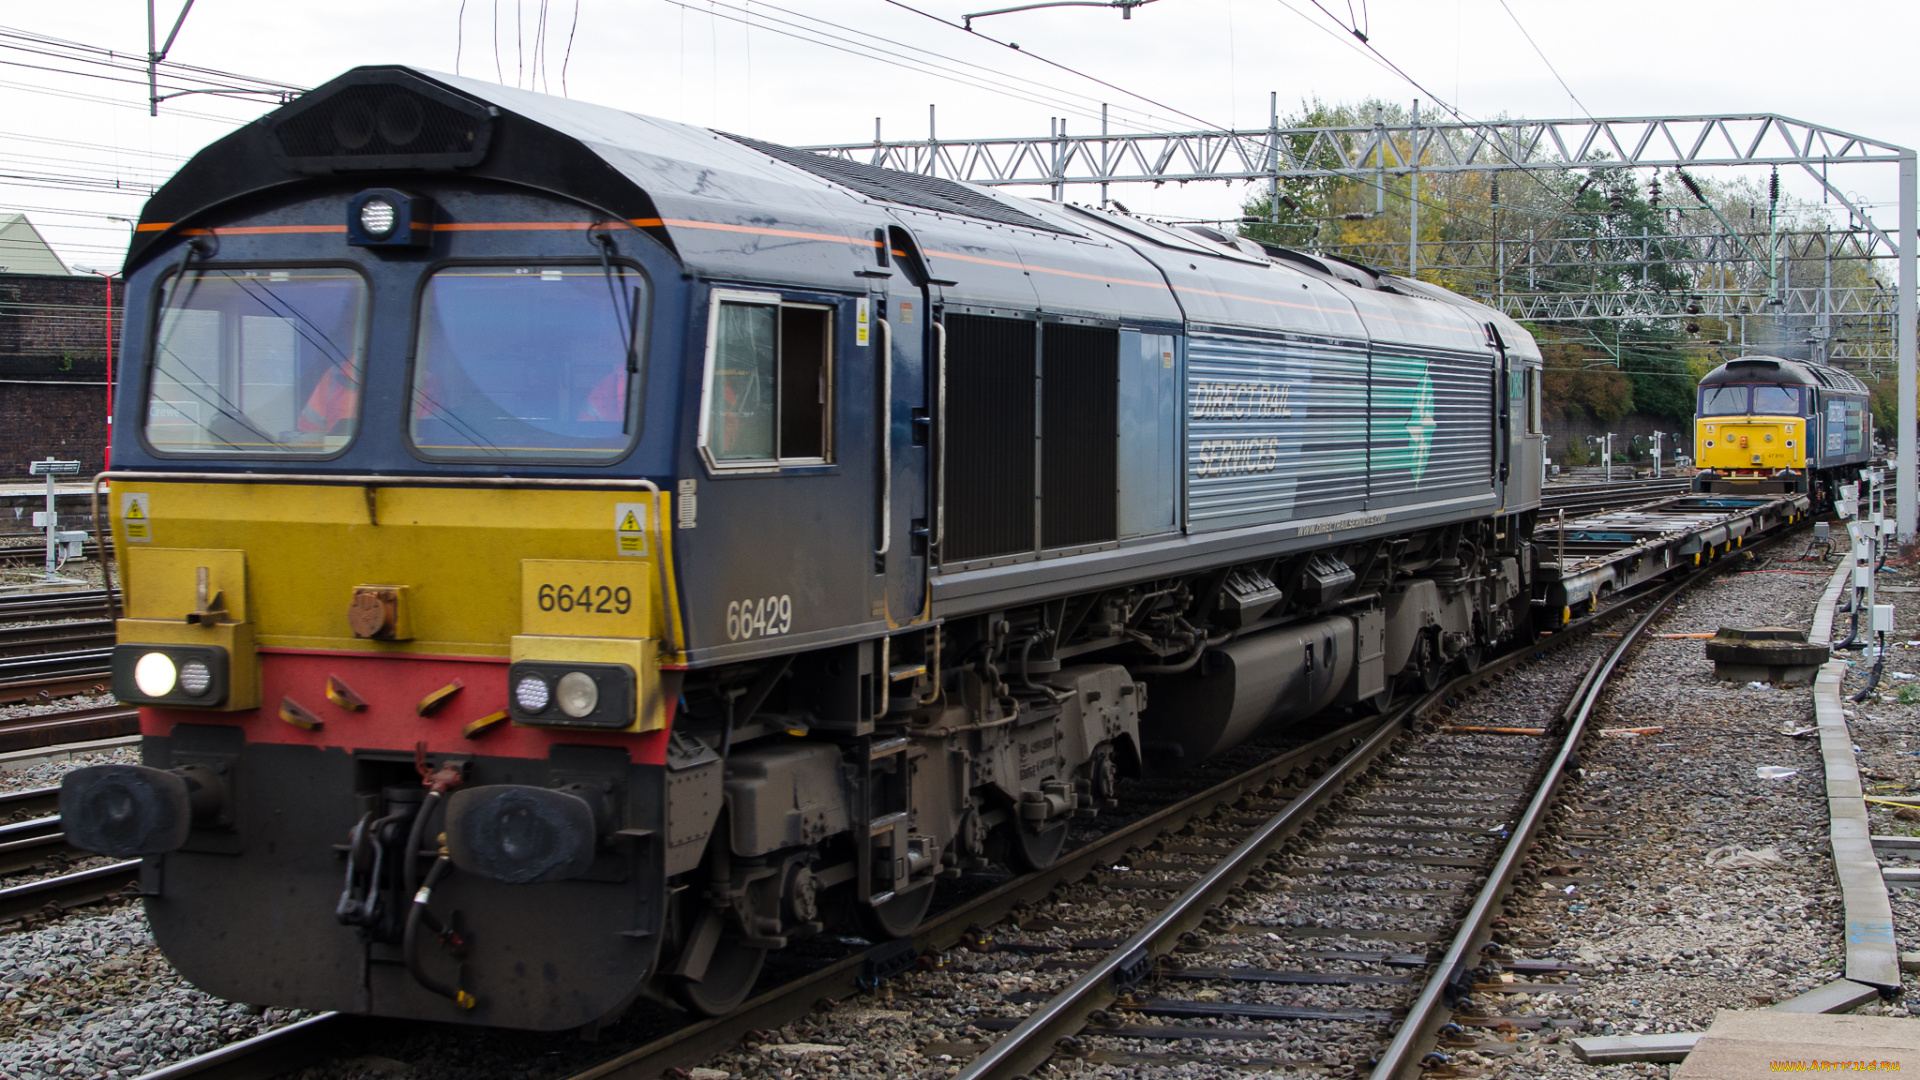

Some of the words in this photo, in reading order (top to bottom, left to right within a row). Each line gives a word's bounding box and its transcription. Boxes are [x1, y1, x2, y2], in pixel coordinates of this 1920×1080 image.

[1193, 382, 1259, 419] DIRECT
[1258, 383, 1291, 418] RAIL
[1510, 372, 1523, 398] DRS
[149, 406, 180, 417] Crewe
[1197, 437, 1279, 478] SERVICES
[538, 584, 632, 614] 66429
[726, 594, 792, 641] 66429
